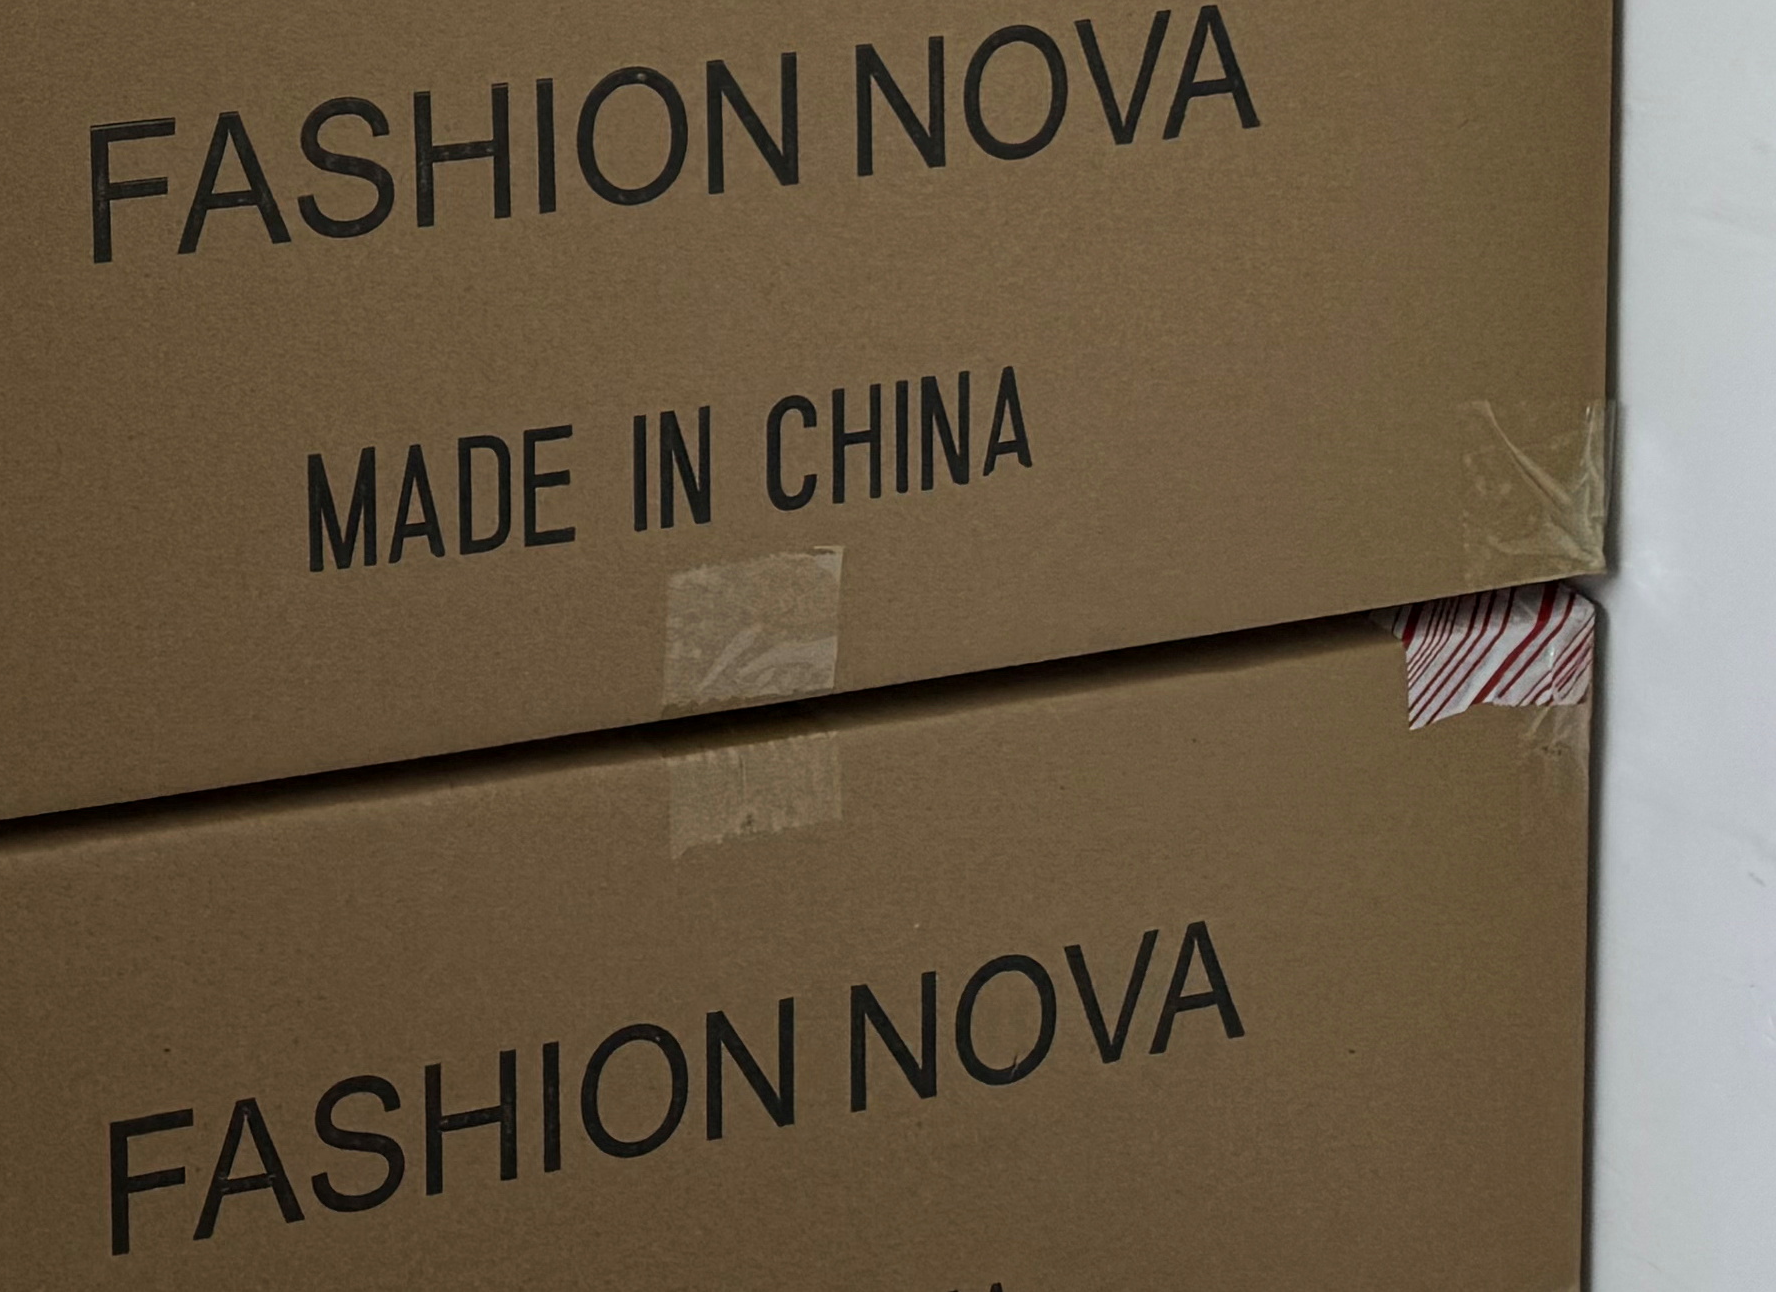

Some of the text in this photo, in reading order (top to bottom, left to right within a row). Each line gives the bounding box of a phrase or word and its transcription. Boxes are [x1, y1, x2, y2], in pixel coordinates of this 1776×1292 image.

[90, 4, 1260, 264] FASHION NOVA
[308, 365, 1033, 572] MADE IN CHINA
[109, 920, 1245, 1257] FASHION NOVA
